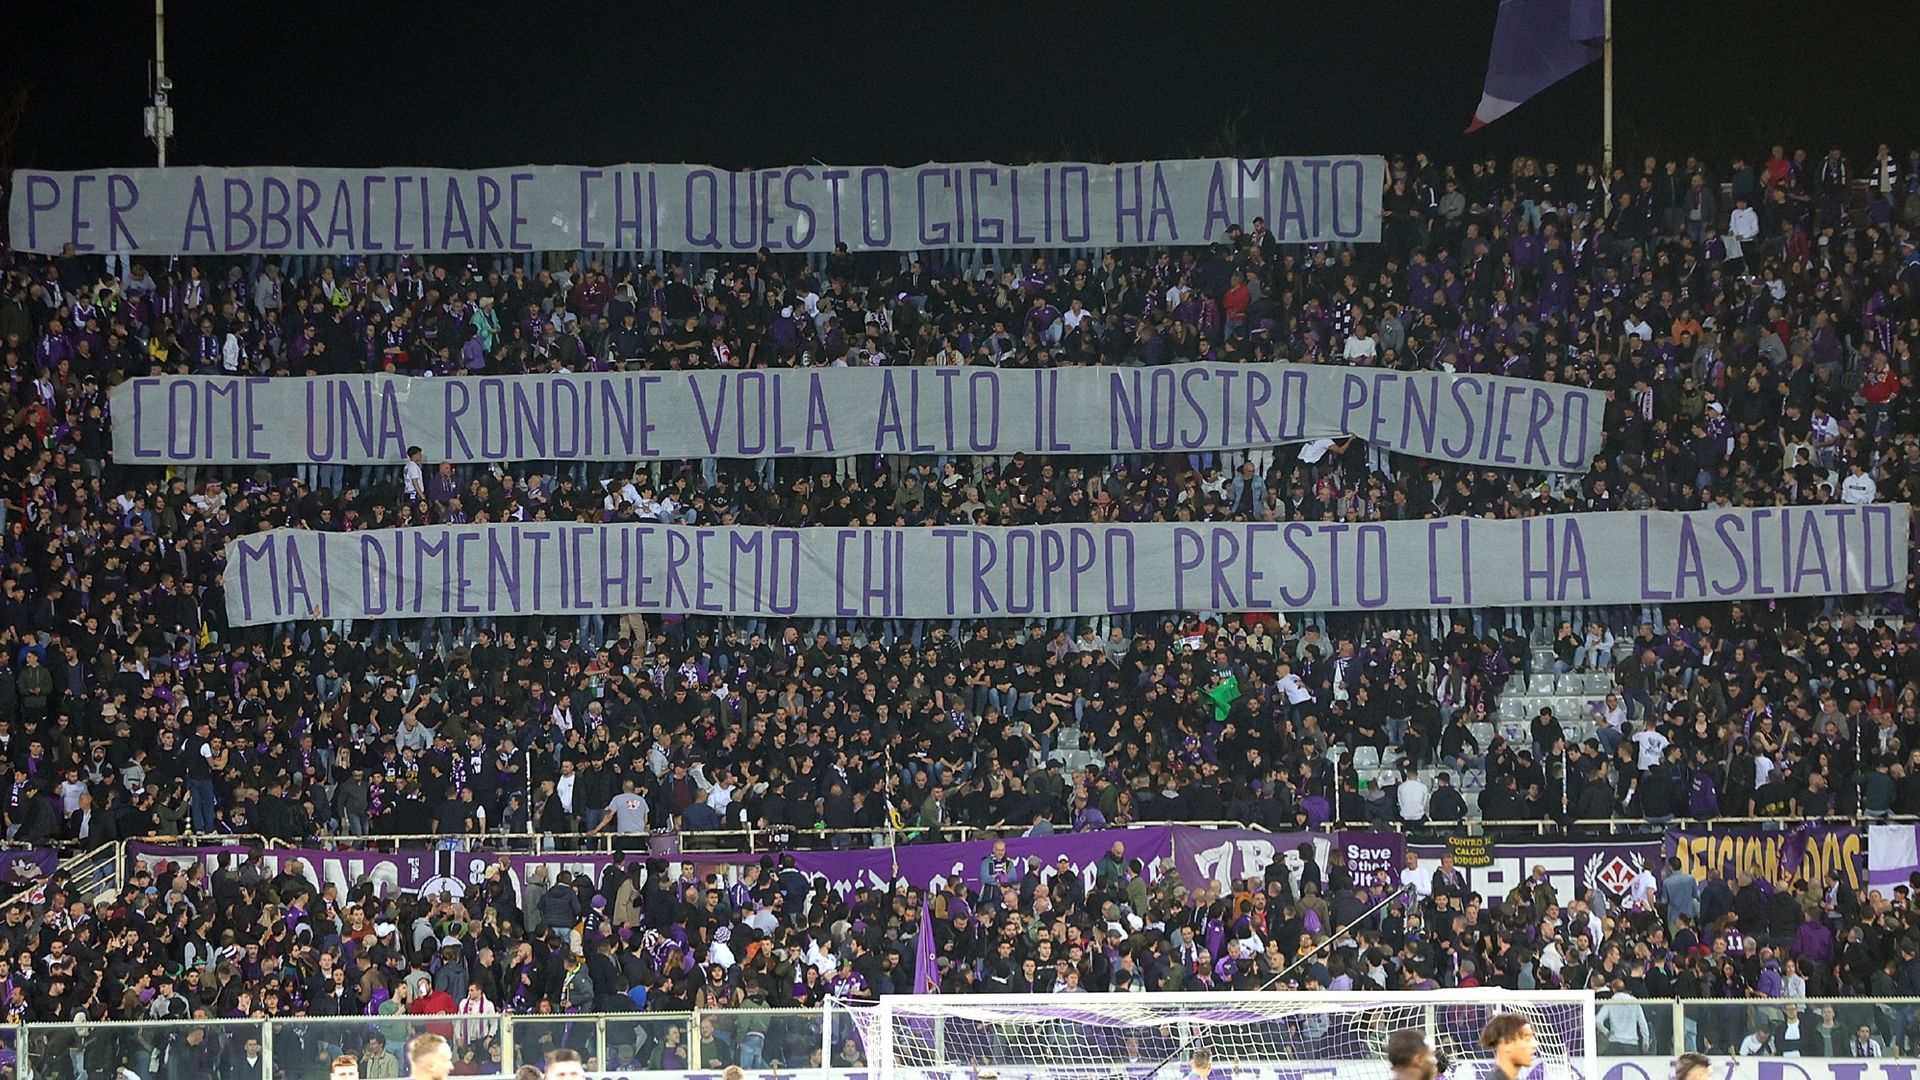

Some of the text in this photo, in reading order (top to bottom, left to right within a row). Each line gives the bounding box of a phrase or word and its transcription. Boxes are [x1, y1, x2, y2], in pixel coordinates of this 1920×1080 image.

[27, 158, 1363, 251] PER ABBRACCIARE CHI QUESTO GIGLIO HA AMATO
[133, 367, 1589, 468] COME UNA RONDINE VOLA ALTO IL NOSTRO PENSIERO
[238, 505, 1894, 621] MAI DIMENTICHEREMO CHI TROPPO PRESTO CI HA LASCIATO
[1448, 836, 1483, 846] CONTRO
[1347, 844, 1392, 860] Save
[1455, 847, 1486, 856] CALCIO
[1453, 855, 1490, 865] ODERNO
[1727, 935, 1743, 951] 11
